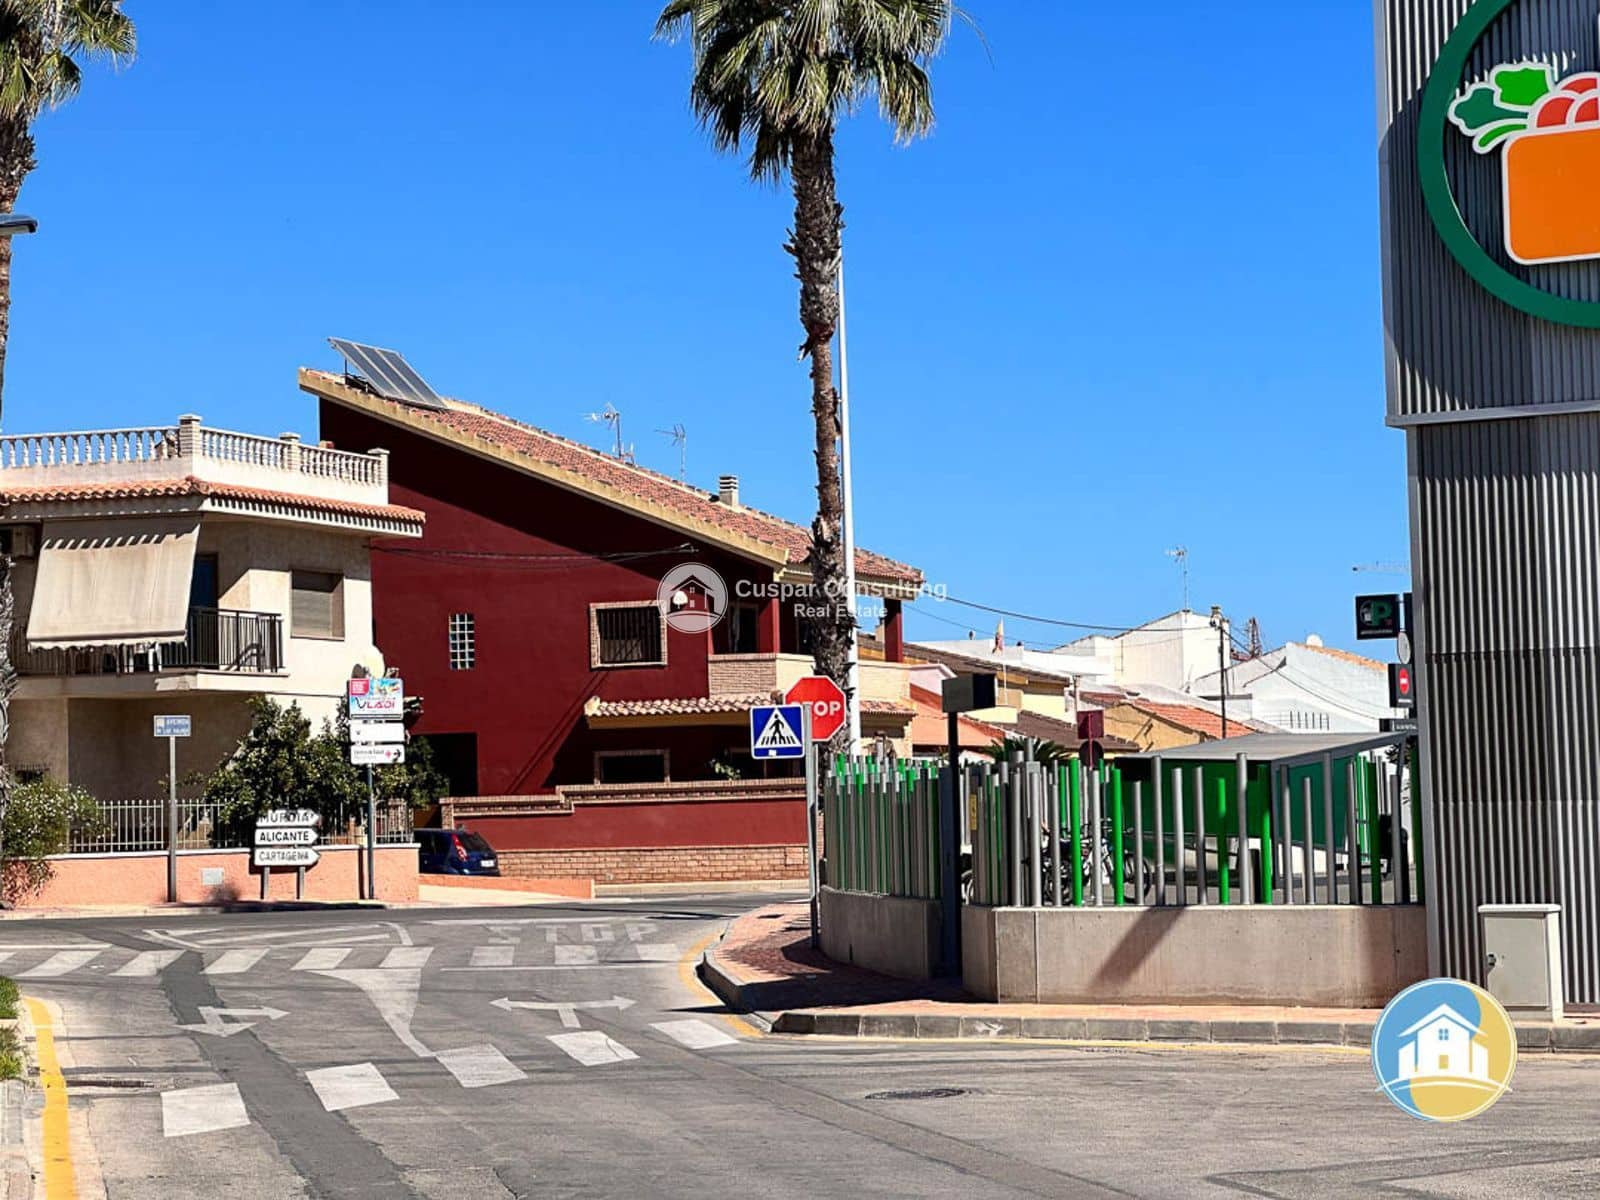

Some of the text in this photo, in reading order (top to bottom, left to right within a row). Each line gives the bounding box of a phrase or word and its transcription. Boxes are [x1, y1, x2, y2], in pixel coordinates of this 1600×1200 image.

[790, 701, 841, 716] TOP
[259, 831, 310, 841] ALICANTE
[258, 851, 309, 861] CARTAGENA
[486, 922, 658, 944] STOP
